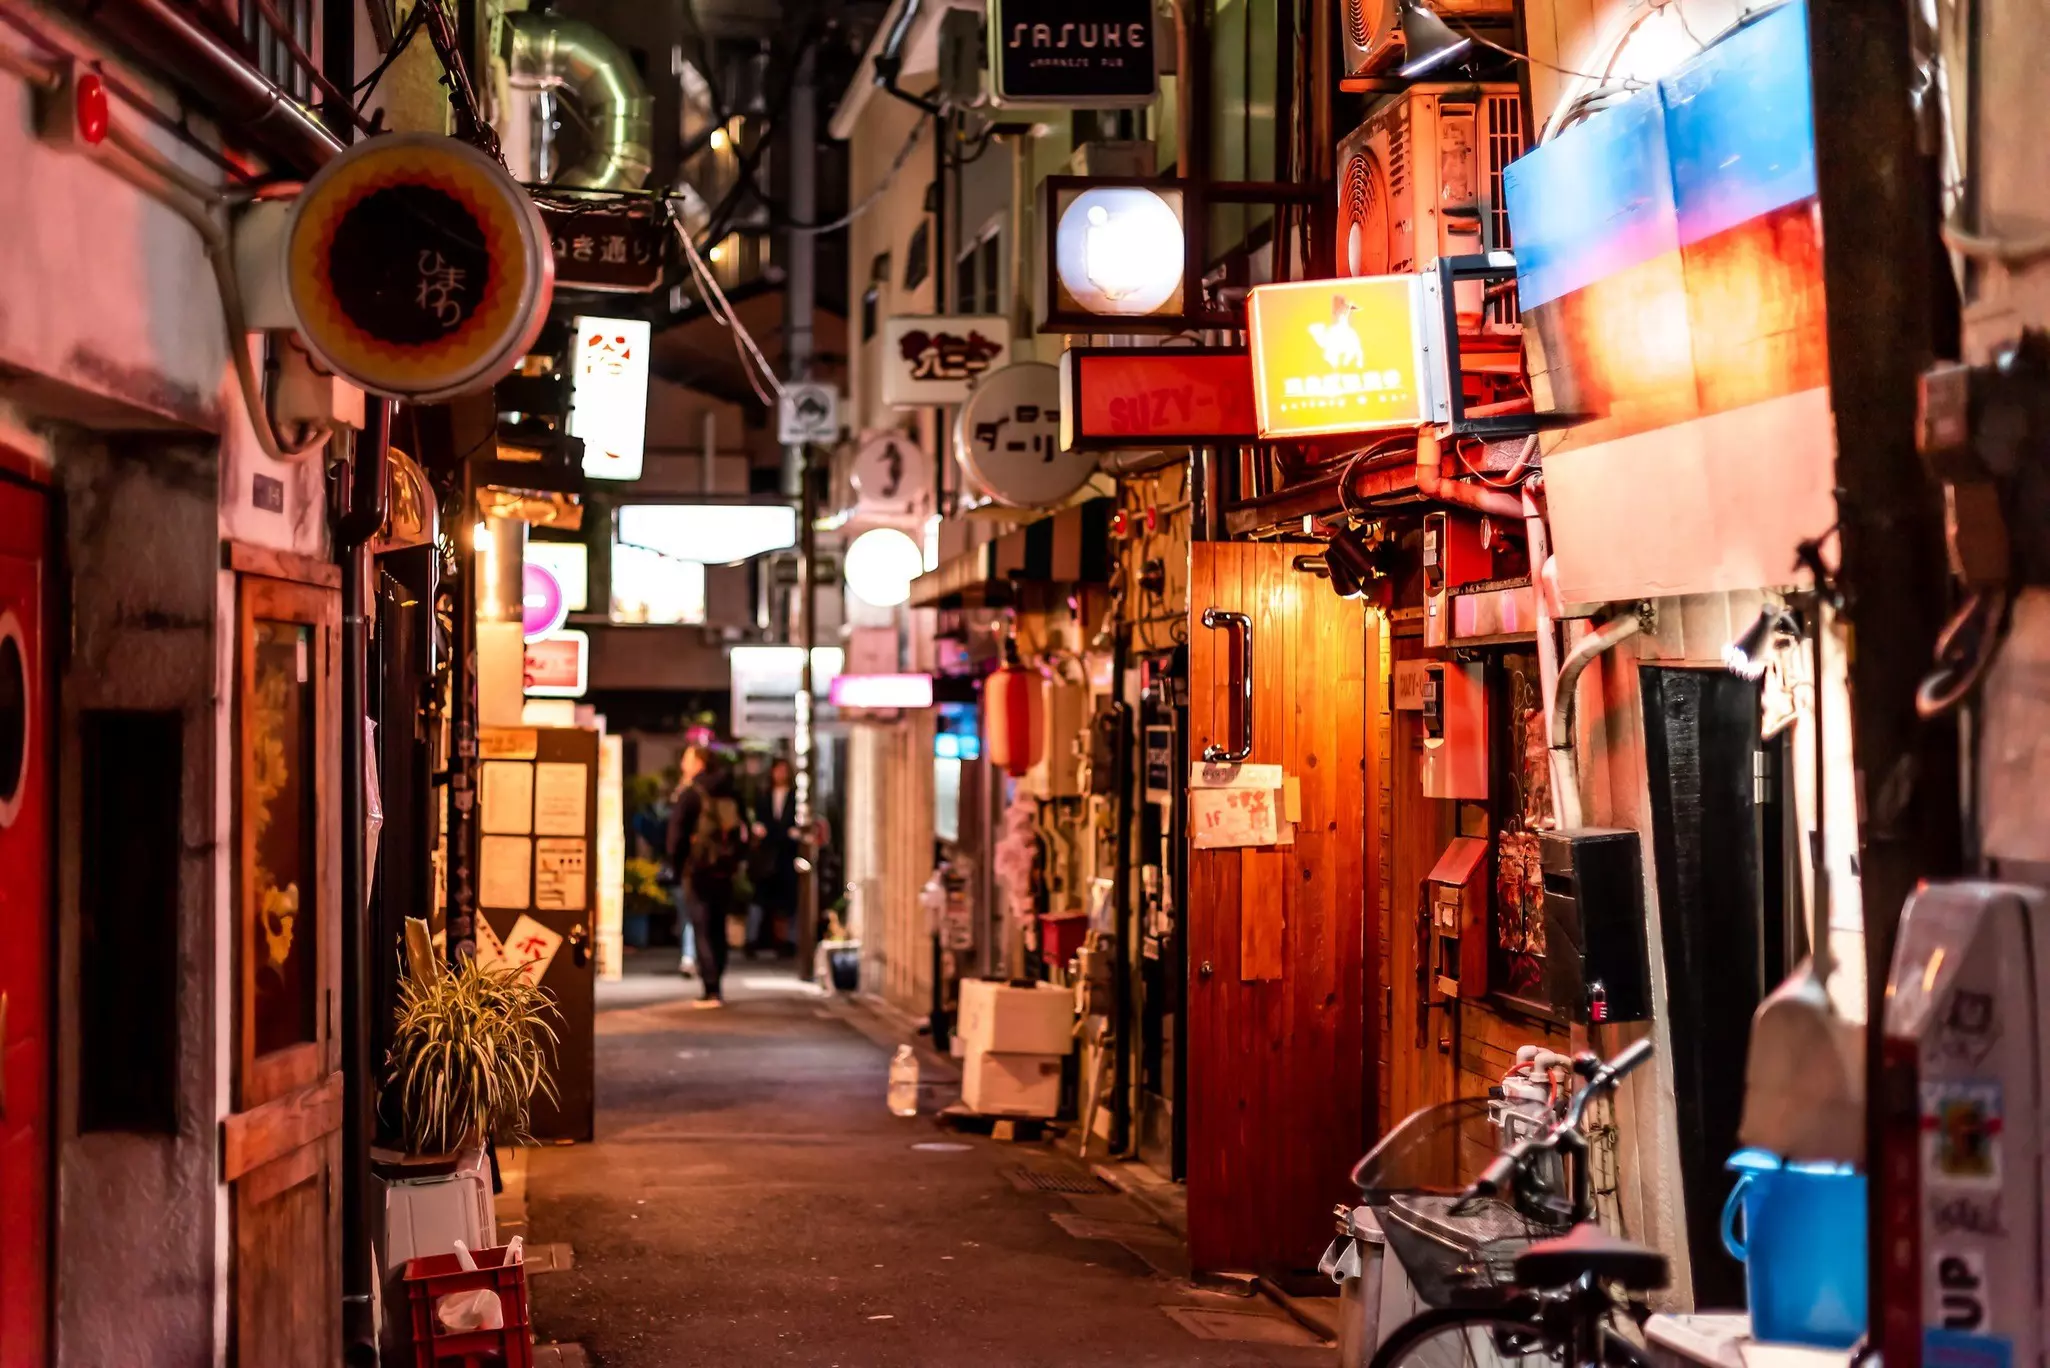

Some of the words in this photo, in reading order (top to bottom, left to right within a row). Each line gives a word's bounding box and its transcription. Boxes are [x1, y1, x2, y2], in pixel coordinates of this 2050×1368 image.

[1008, 22, 1146, 48] SASUKE
[415, 249, 467, 327] ひまわり
[1108, 384, 1246, 433] SUZY-
